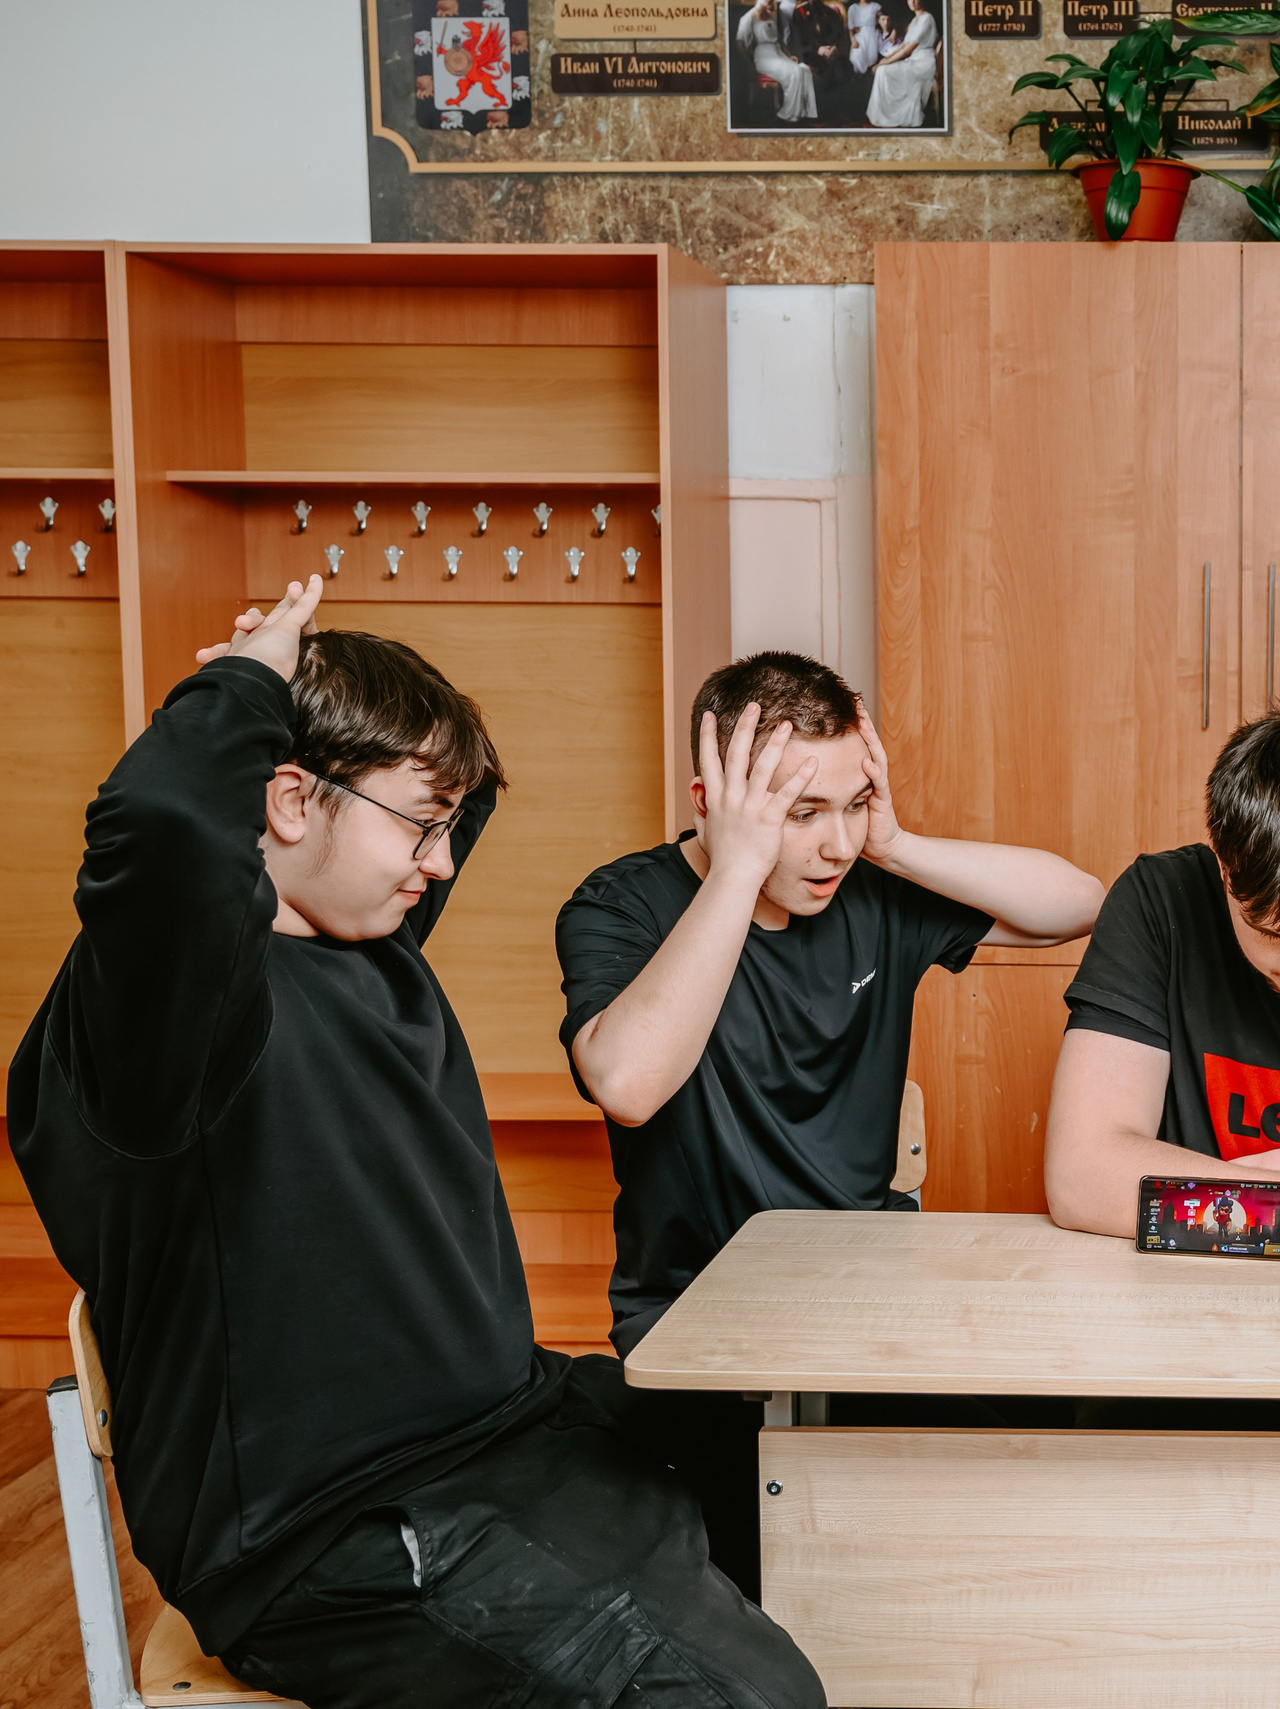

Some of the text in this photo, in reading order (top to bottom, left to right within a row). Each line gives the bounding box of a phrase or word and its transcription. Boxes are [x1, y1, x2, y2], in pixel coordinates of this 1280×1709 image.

[1019, 0, 1034, 16] II
[1113, 0, 1135, 16] III
[559, 56, 711, 74] Иван VI Антонович
[1177, 115, 1242, 130] Николай
